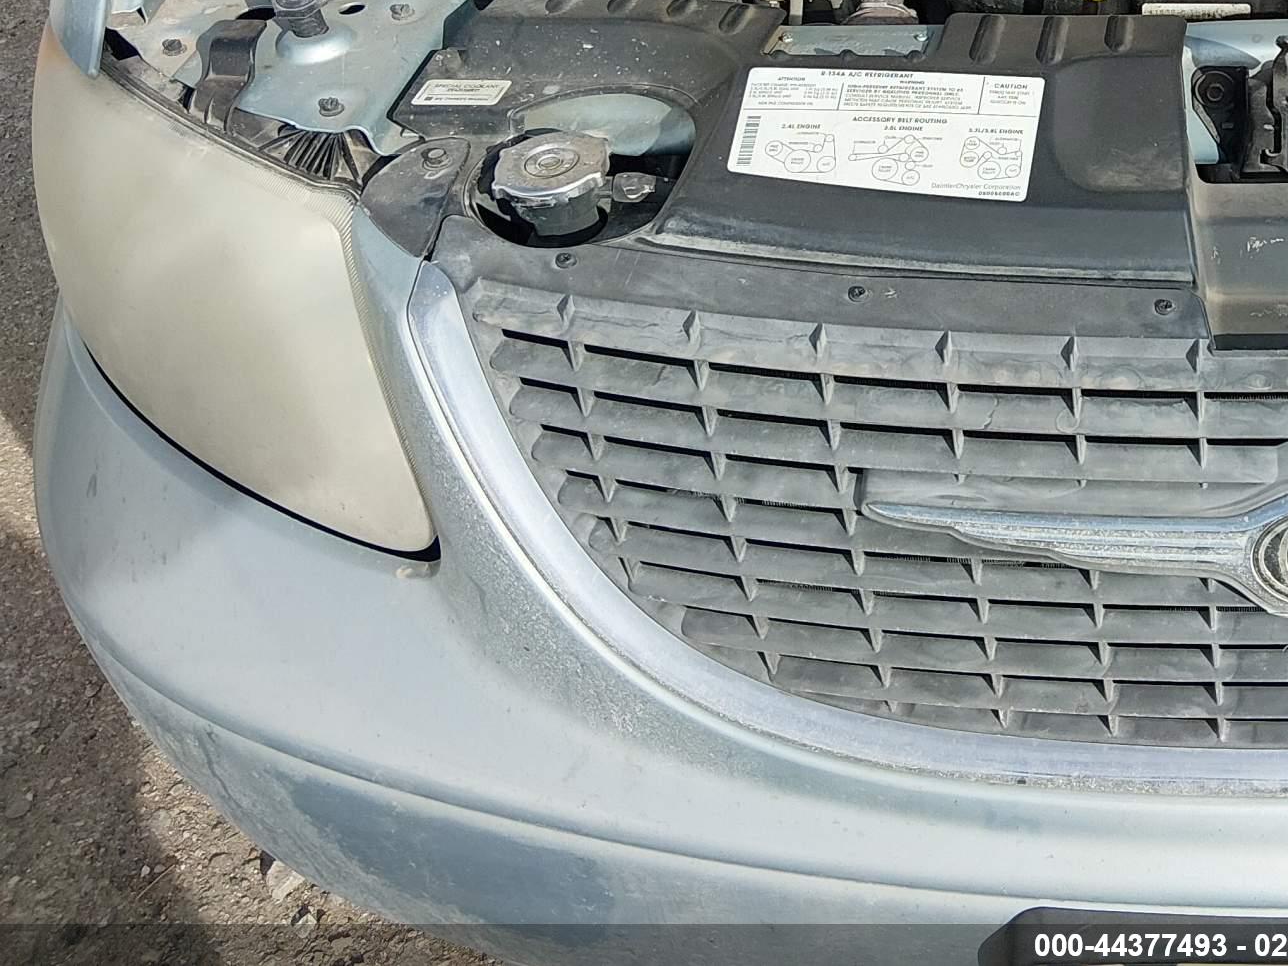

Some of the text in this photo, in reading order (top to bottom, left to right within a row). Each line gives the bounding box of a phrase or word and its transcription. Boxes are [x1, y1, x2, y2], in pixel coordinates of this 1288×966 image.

[914, 117, 948, 125] ROUTING
[931, 182, 1021, 191] DaimlerChrysler Corporation
